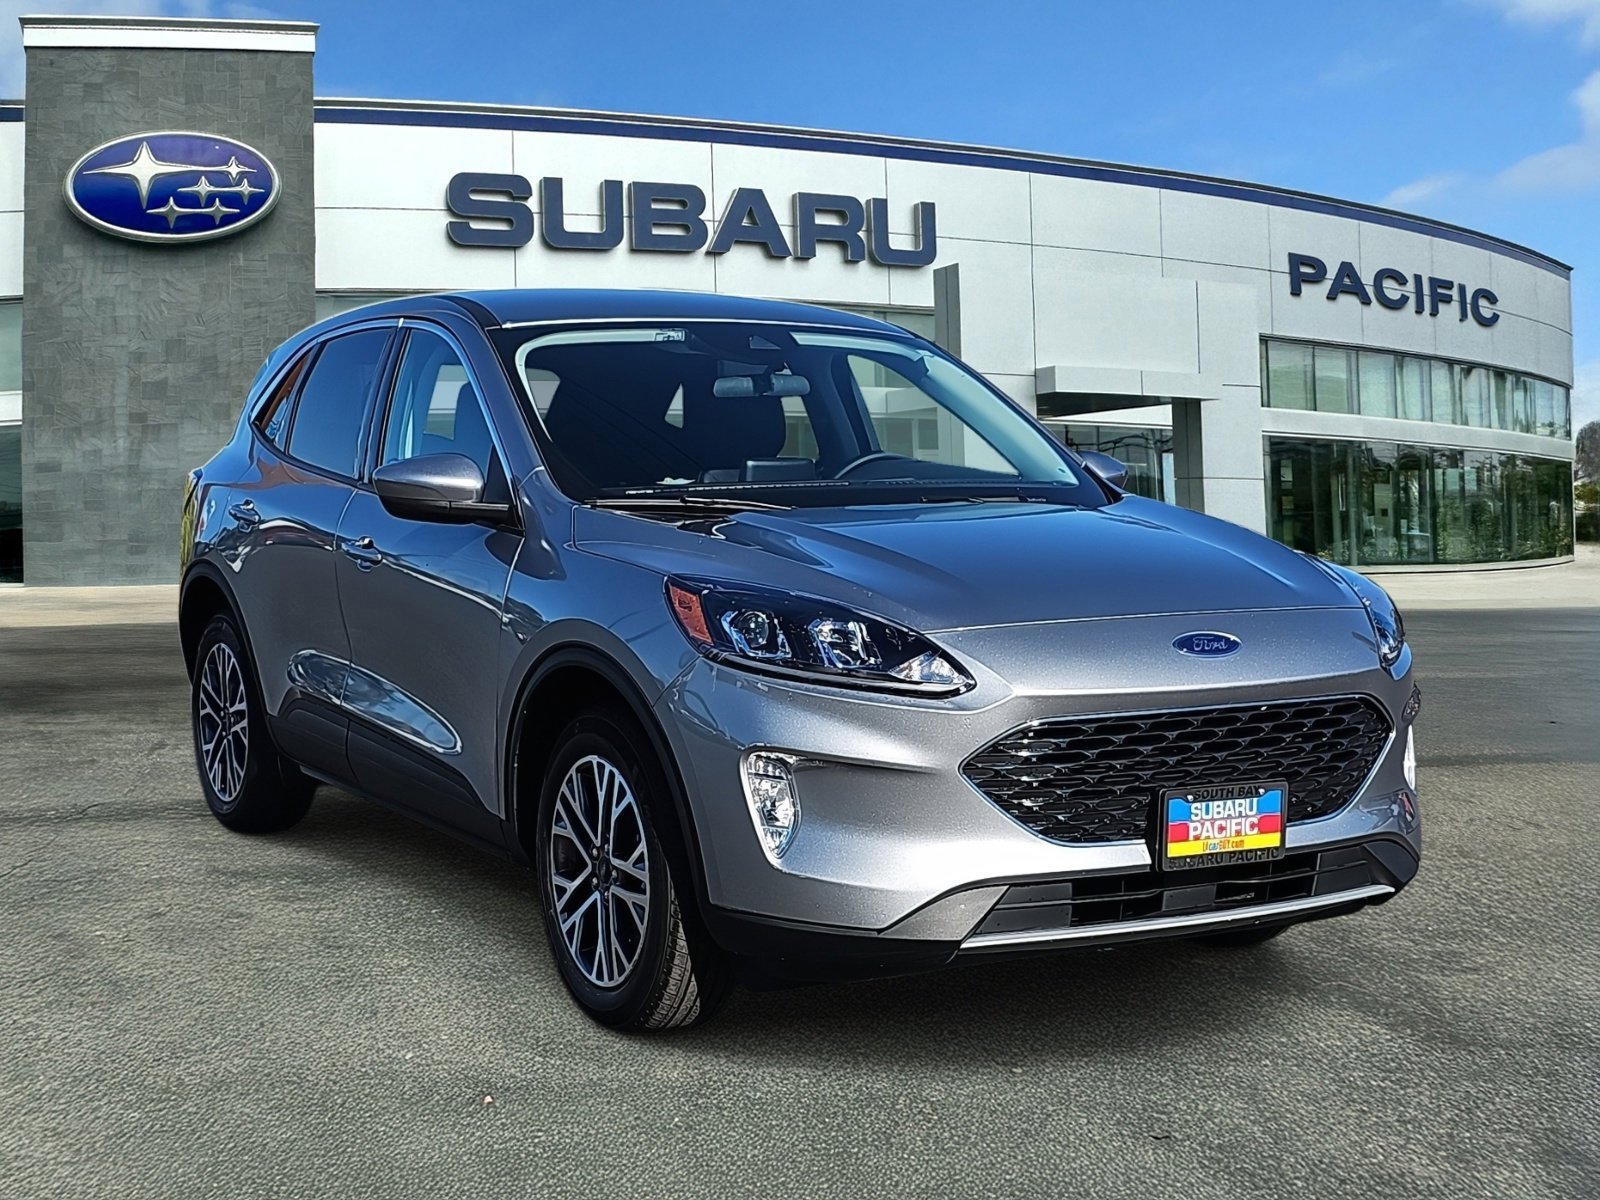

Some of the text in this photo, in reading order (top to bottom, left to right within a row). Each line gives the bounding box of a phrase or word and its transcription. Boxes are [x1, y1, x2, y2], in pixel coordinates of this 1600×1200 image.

[446, 171, 937, 268] SUBARU
[1288, 252, 1500, 328] PACIFIC
[1193, 636, 1228, 651] Ford
[1195, 785, 1261, 799] SOUTH BAY
[1191, 798, 1257, 820] SUBARU
[1189, 817, 1259, 841] PACIFIC
[1229, 848, 1279, 862] PACIFIC
